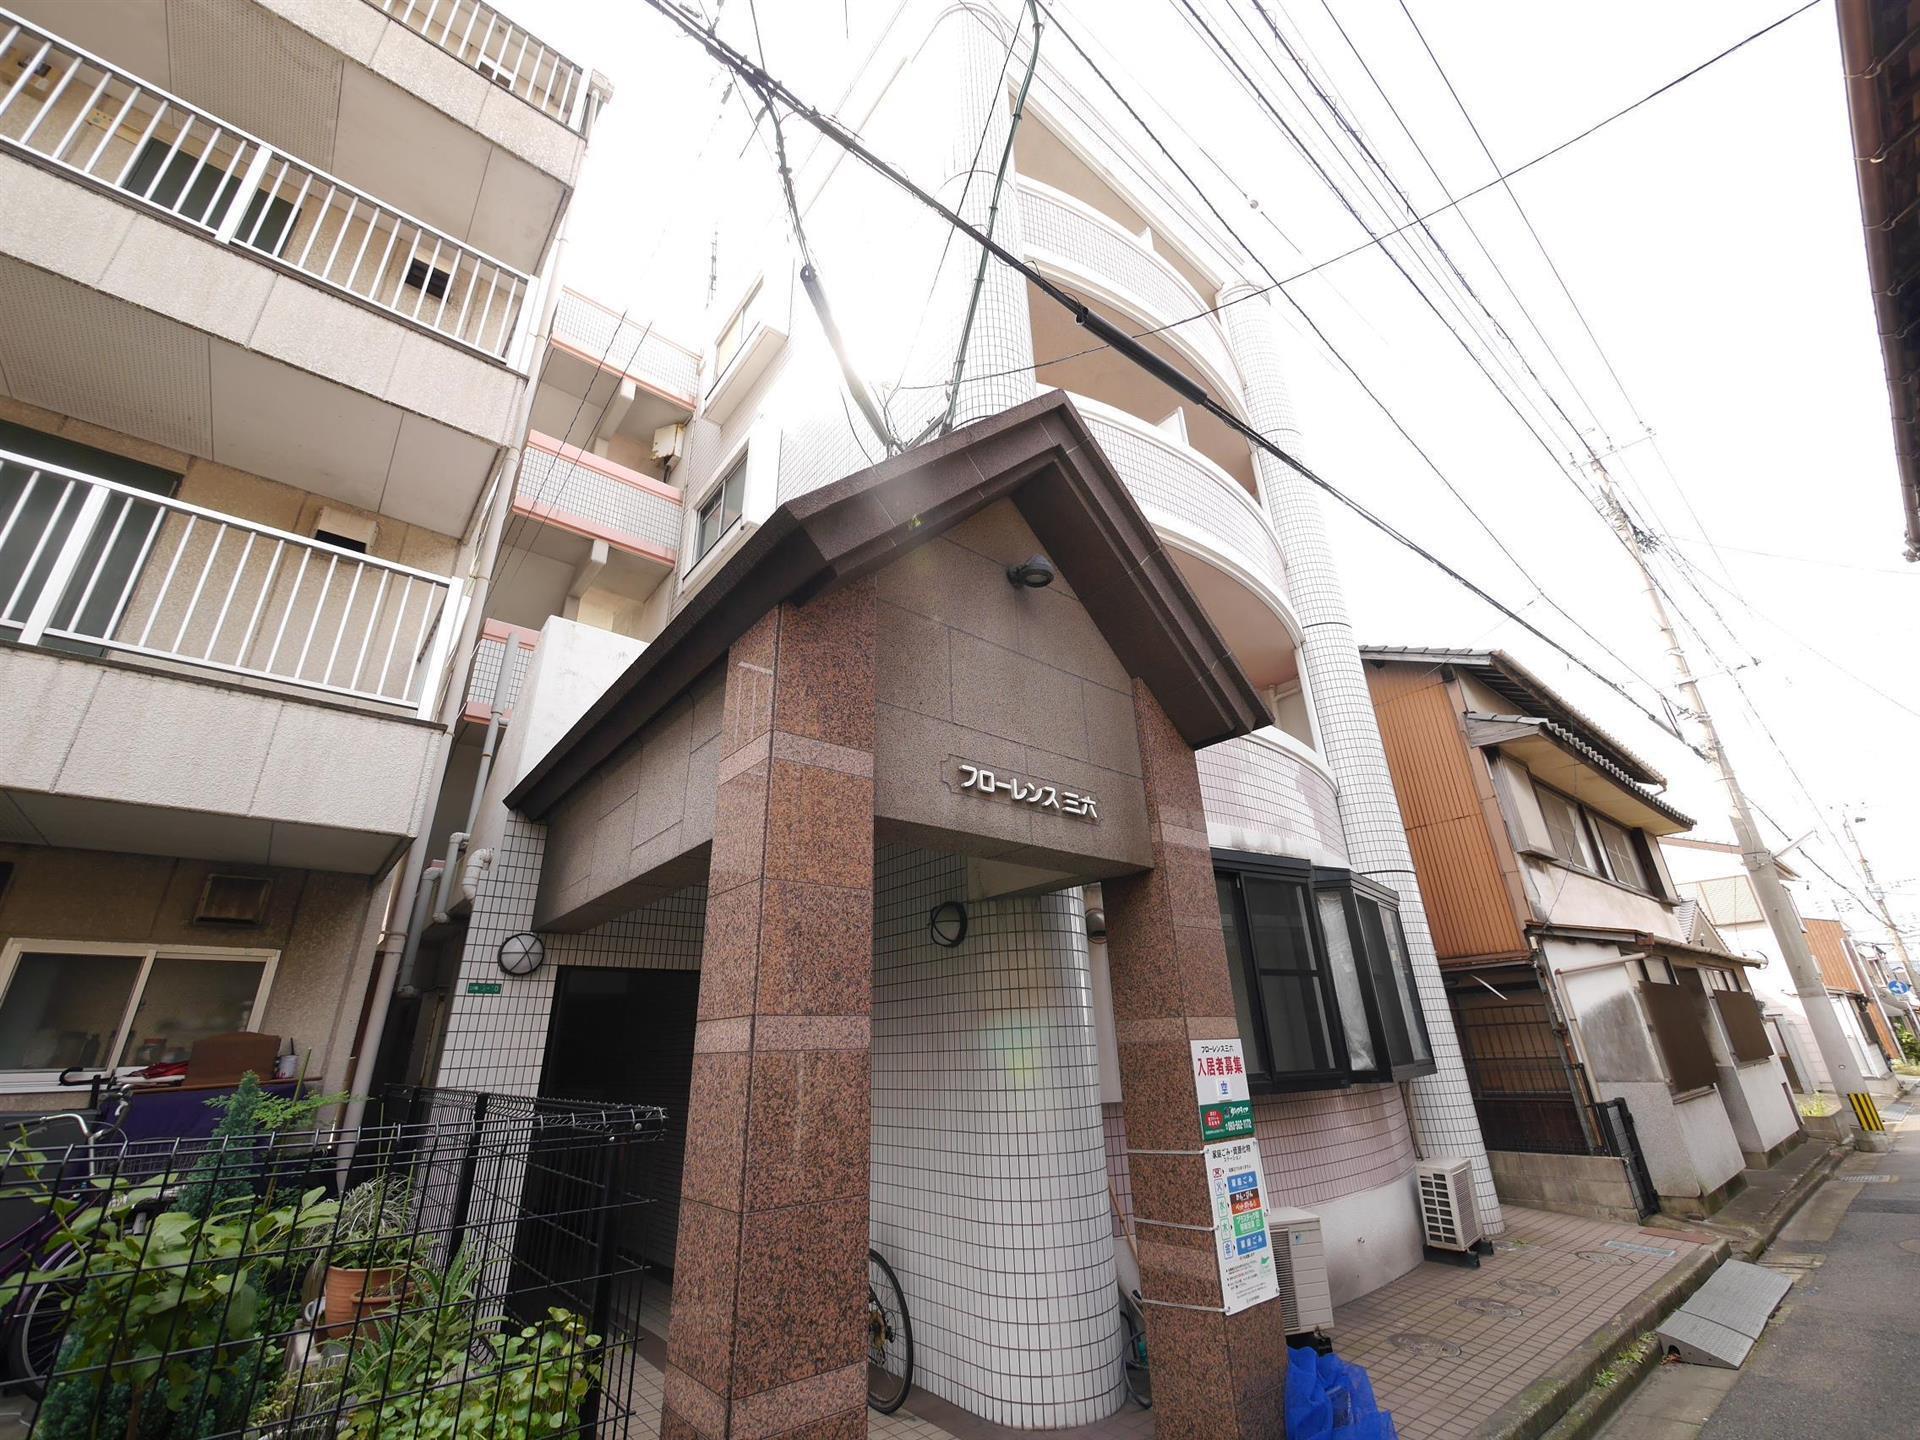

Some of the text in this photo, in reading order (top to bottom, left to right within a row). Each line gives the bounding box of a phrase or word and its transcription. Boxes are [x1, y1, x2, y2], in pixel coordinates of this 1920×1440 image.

[959, 764, 1098, 818] フローレンス三六
[1201, 1044, 1234, 1053] フローレンス三六
[1198, 1056, 1243, 1076] 入居者募集
[1221, 1081, 1228, 1095] 空
